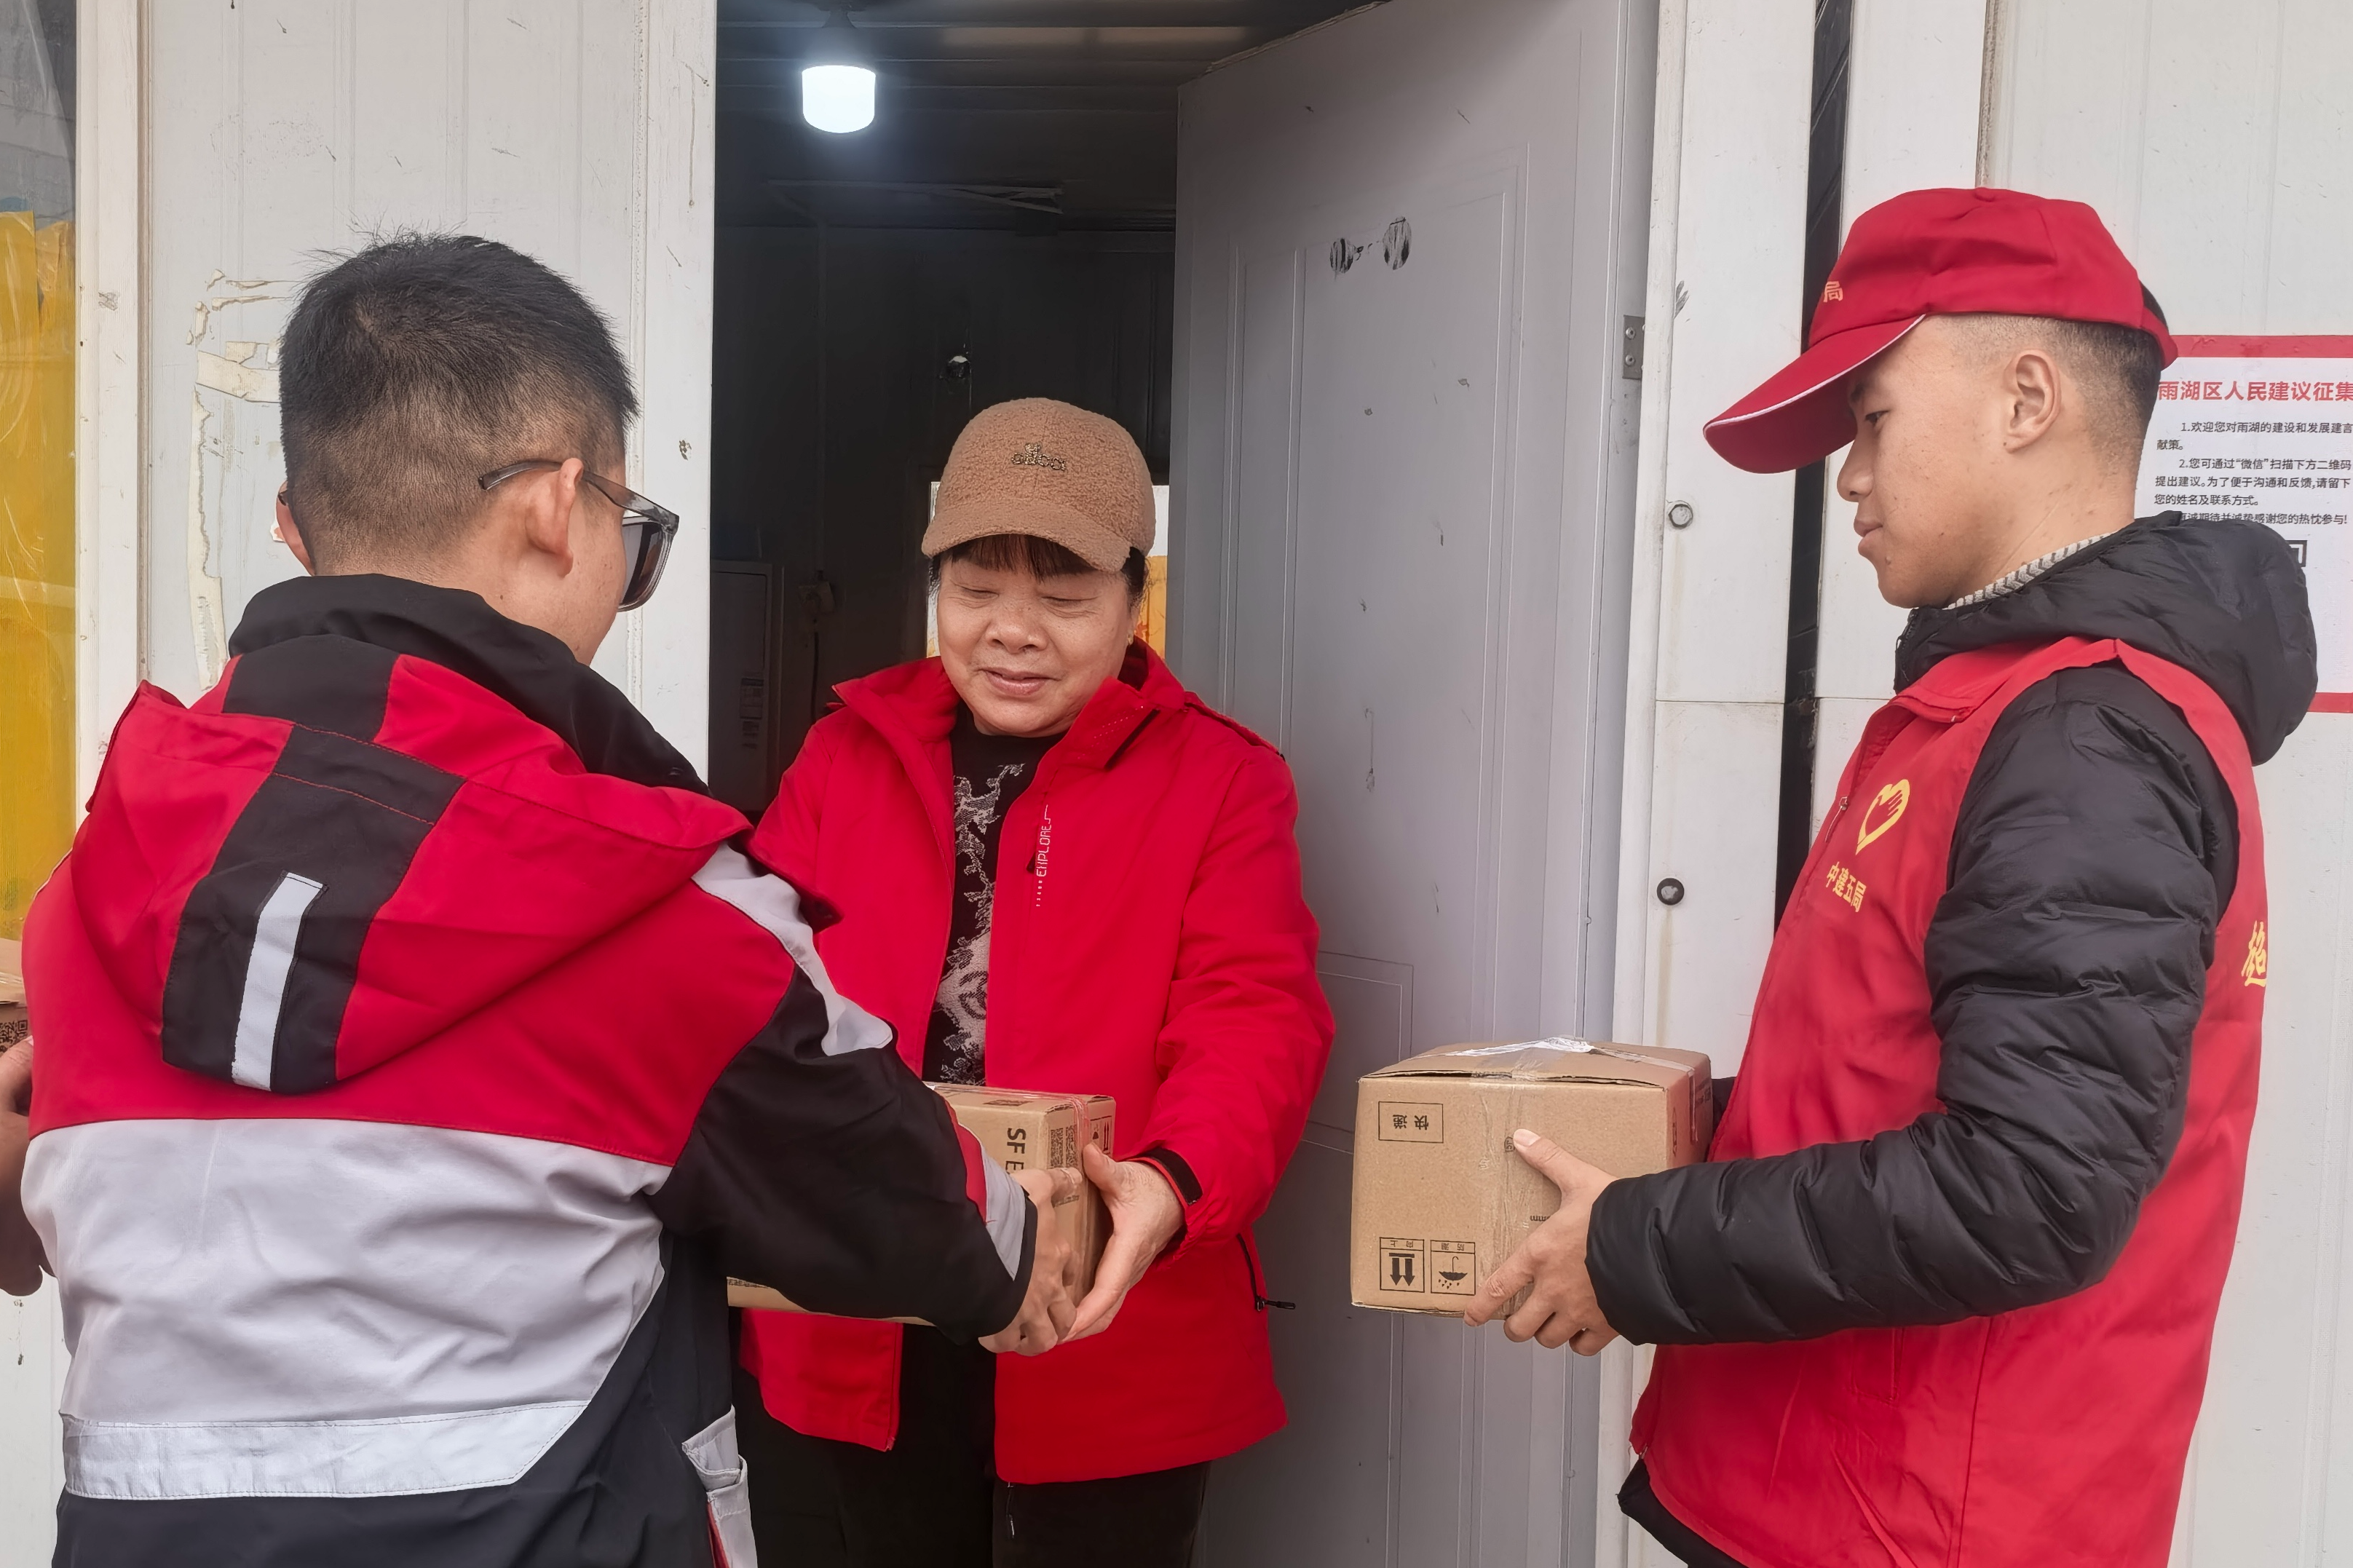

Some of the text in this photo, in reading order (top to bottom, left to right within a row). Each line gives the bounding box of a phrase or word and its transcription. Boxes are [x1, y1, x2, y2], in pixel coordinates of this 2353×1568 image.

[1824, 281, 1843, 303] 局
[2159, 381, 2353, 402] 雨湖区人民建议征集
[2156, 439, 2183, 451] 献策。
[2154, 494, 2258, 506] 您的姓名及联系方式。
[1826, 861, 1867, 913] 中建五局
[1392, 1114, 1429, 1131] 快递
[1005, 1128, 1027, 1175] SF E
